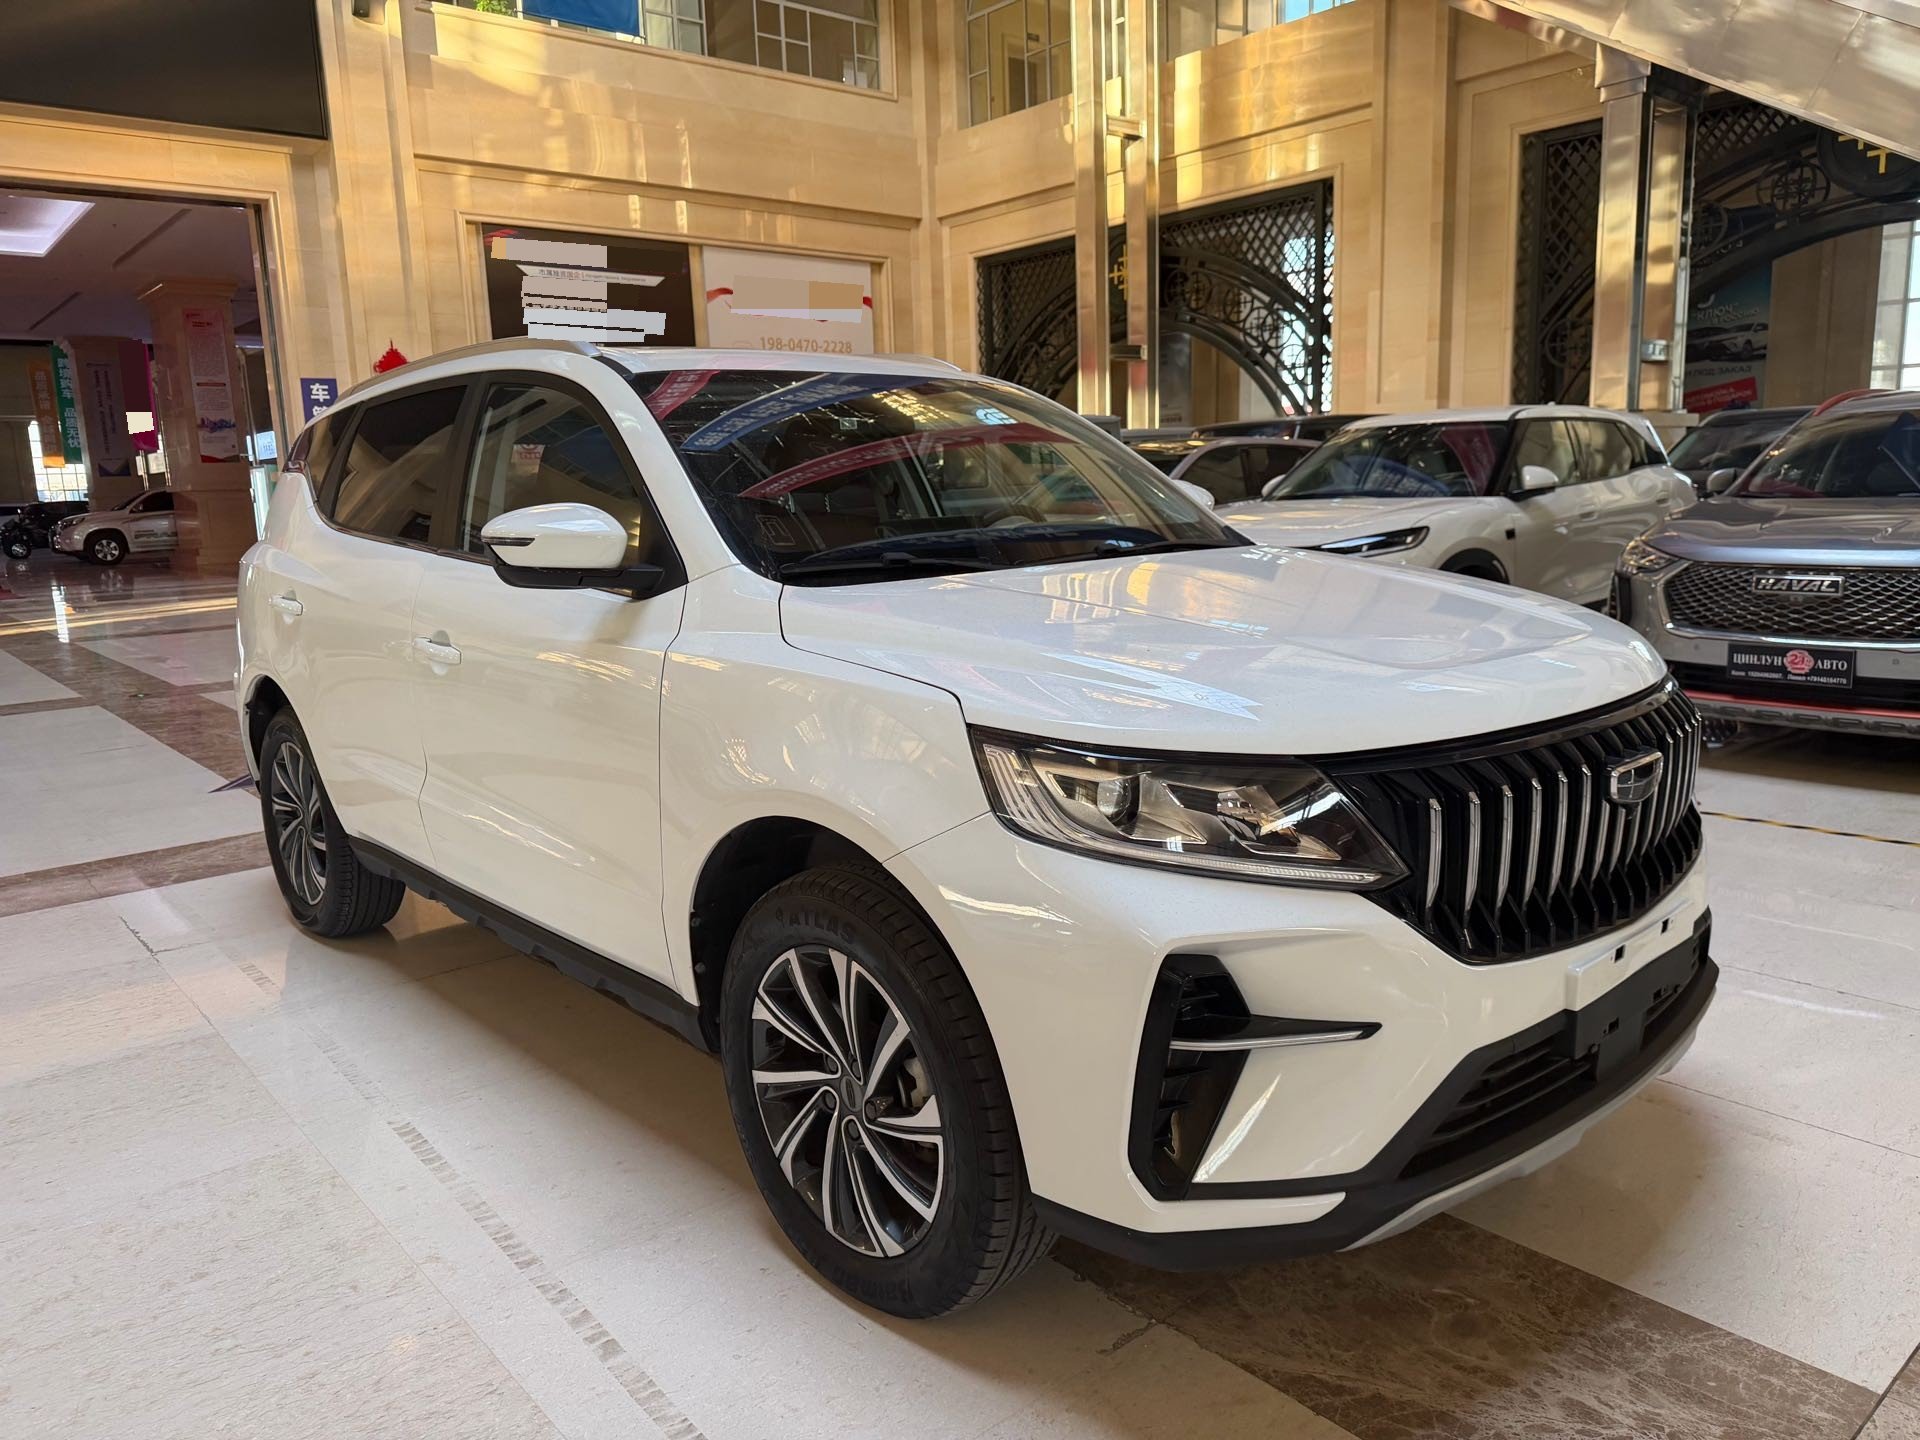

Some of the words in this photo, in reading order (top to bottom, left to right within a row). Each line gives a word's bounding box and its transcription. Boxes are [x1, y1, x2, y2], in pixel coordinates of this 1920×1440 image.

[759, 336, 853, 353] 198-0470-2228
[1758, 579, 1836, 592] HAVAL
[1733, 653, 1782, 666] ЦИНЛУН
[1815, 658, 1848, 671] АВТО
